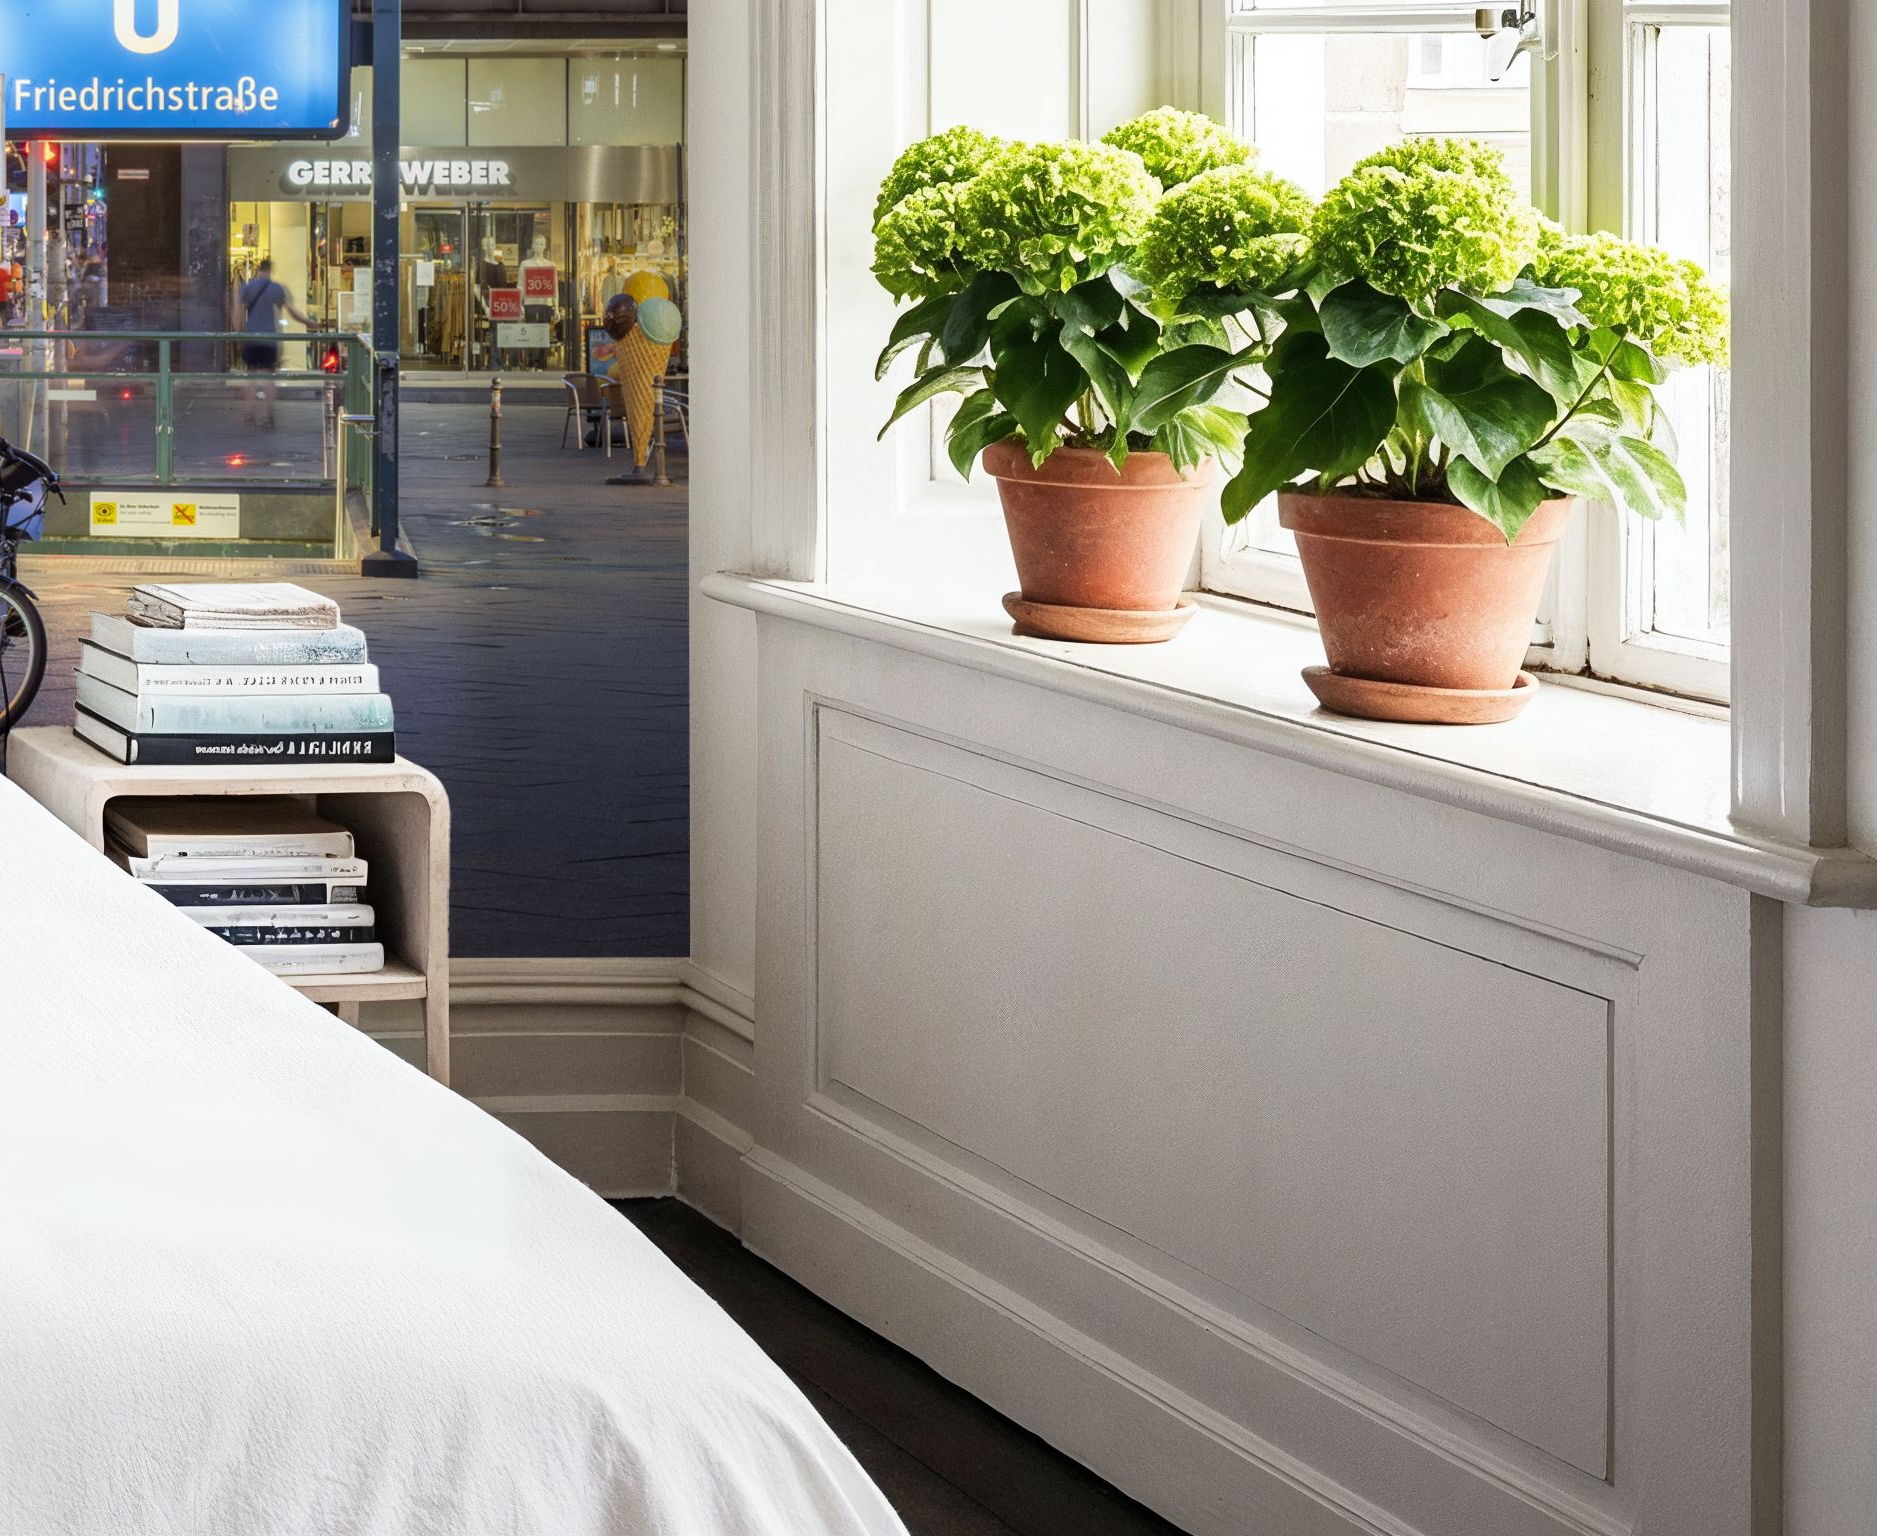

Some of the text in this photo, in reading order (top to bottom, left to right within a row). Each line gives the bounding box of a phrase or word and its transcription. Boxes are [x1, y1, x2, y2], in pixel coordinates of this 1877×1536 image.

[13, 76, 280, 113] Friedrichstraße
[288, 160, 511, 185] GERR WEBER
[527, 278, 553, 291] 30%
[494, 300, 519, 313] 50%
